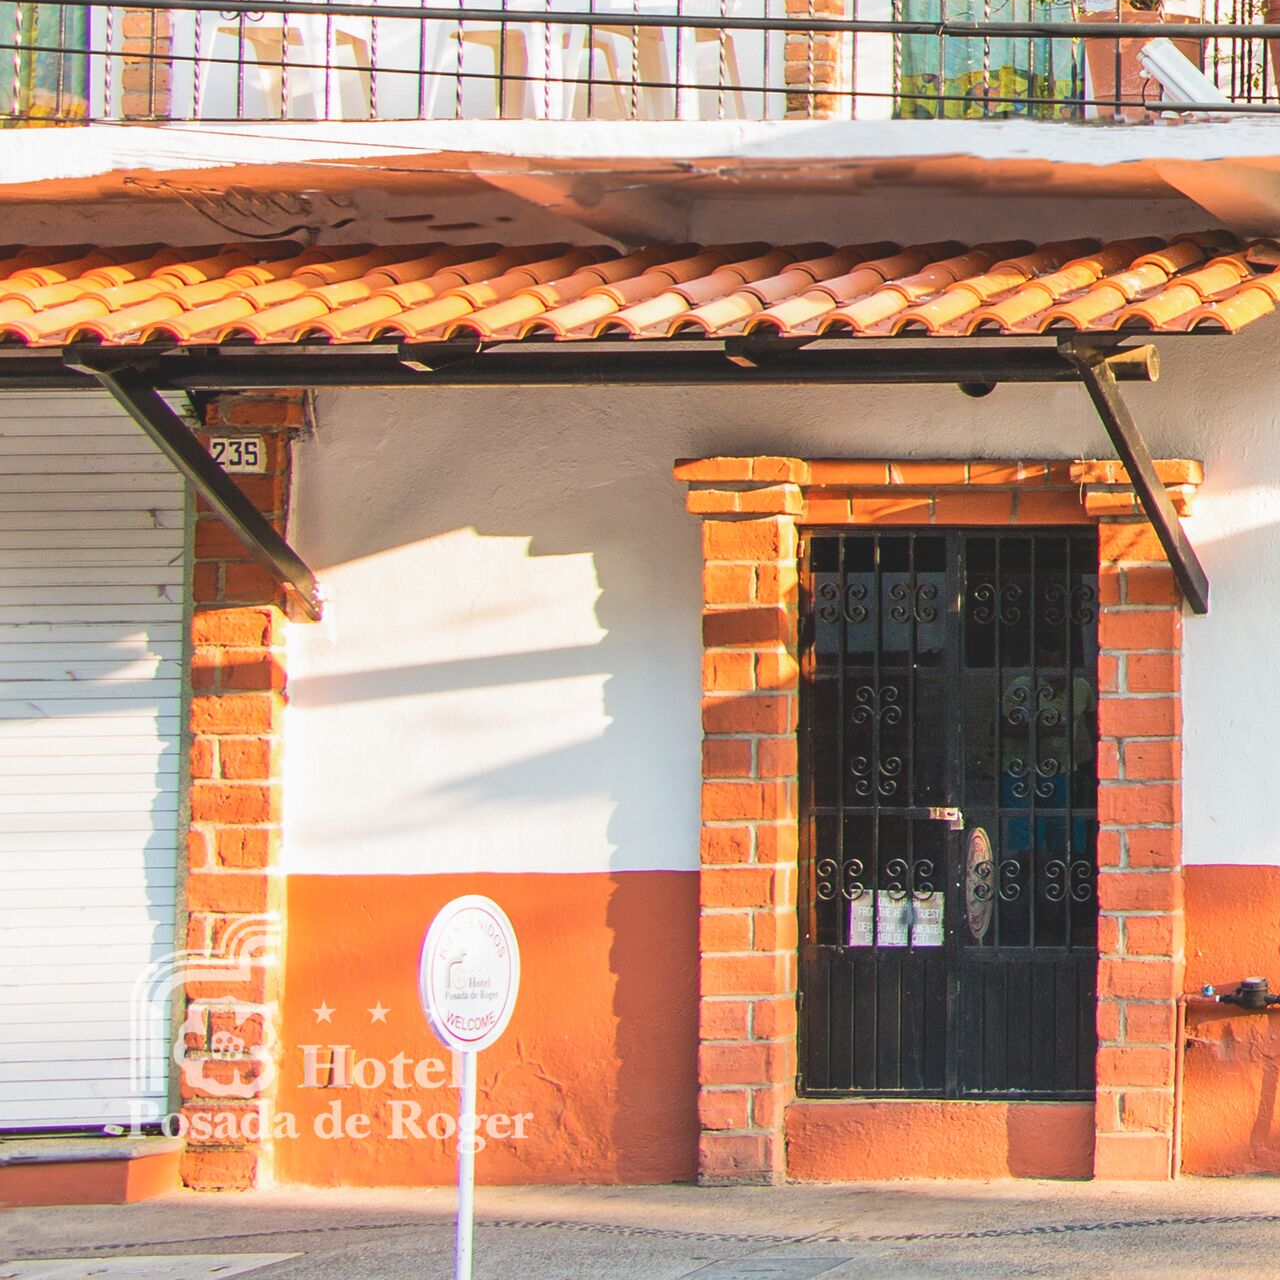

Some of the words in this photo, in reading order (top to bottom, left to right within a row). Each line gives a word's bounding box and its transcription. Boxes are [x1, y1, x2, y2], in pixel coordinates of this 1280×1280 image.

[212, 441, 258, 466] 235
[468, 977, 491, 988] Hotel
[446, 1010, 496, 1031] WELCOME
